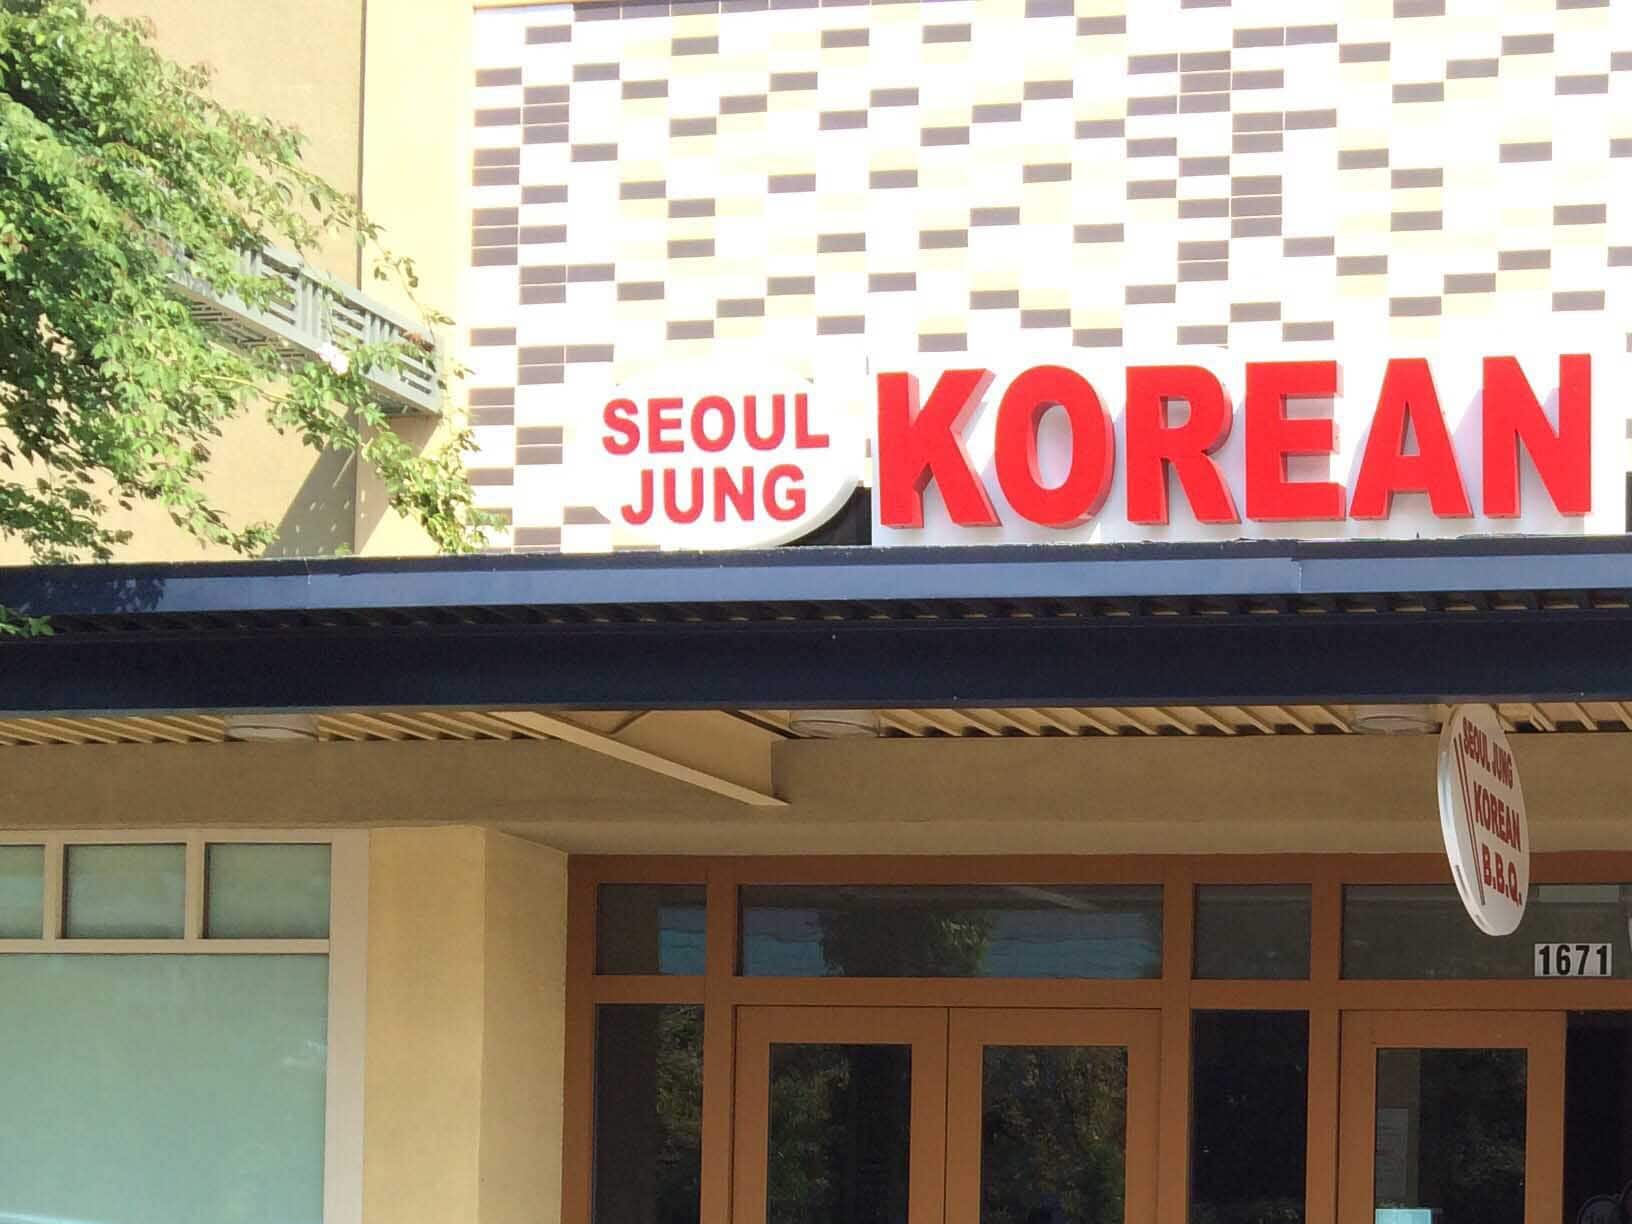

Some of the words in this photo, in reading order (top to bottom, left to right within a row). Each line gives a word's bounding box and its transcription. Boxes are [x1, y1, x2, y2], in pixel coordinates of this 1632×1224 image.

[602, 394, 829, 456] SEOUL
[876, 354, 1593, 529] KOREAN
[621, 465, 806, 524] JUNG
[1463, 716, 1491, 773] SEOUL
[1492, 741, 1513, 789] JUNG
[1473, 780, 1521, 852] KOREAN
[1482, 843, 1522, 907] B.B.Q.
[1539, 945, 1608, 976] 1671
